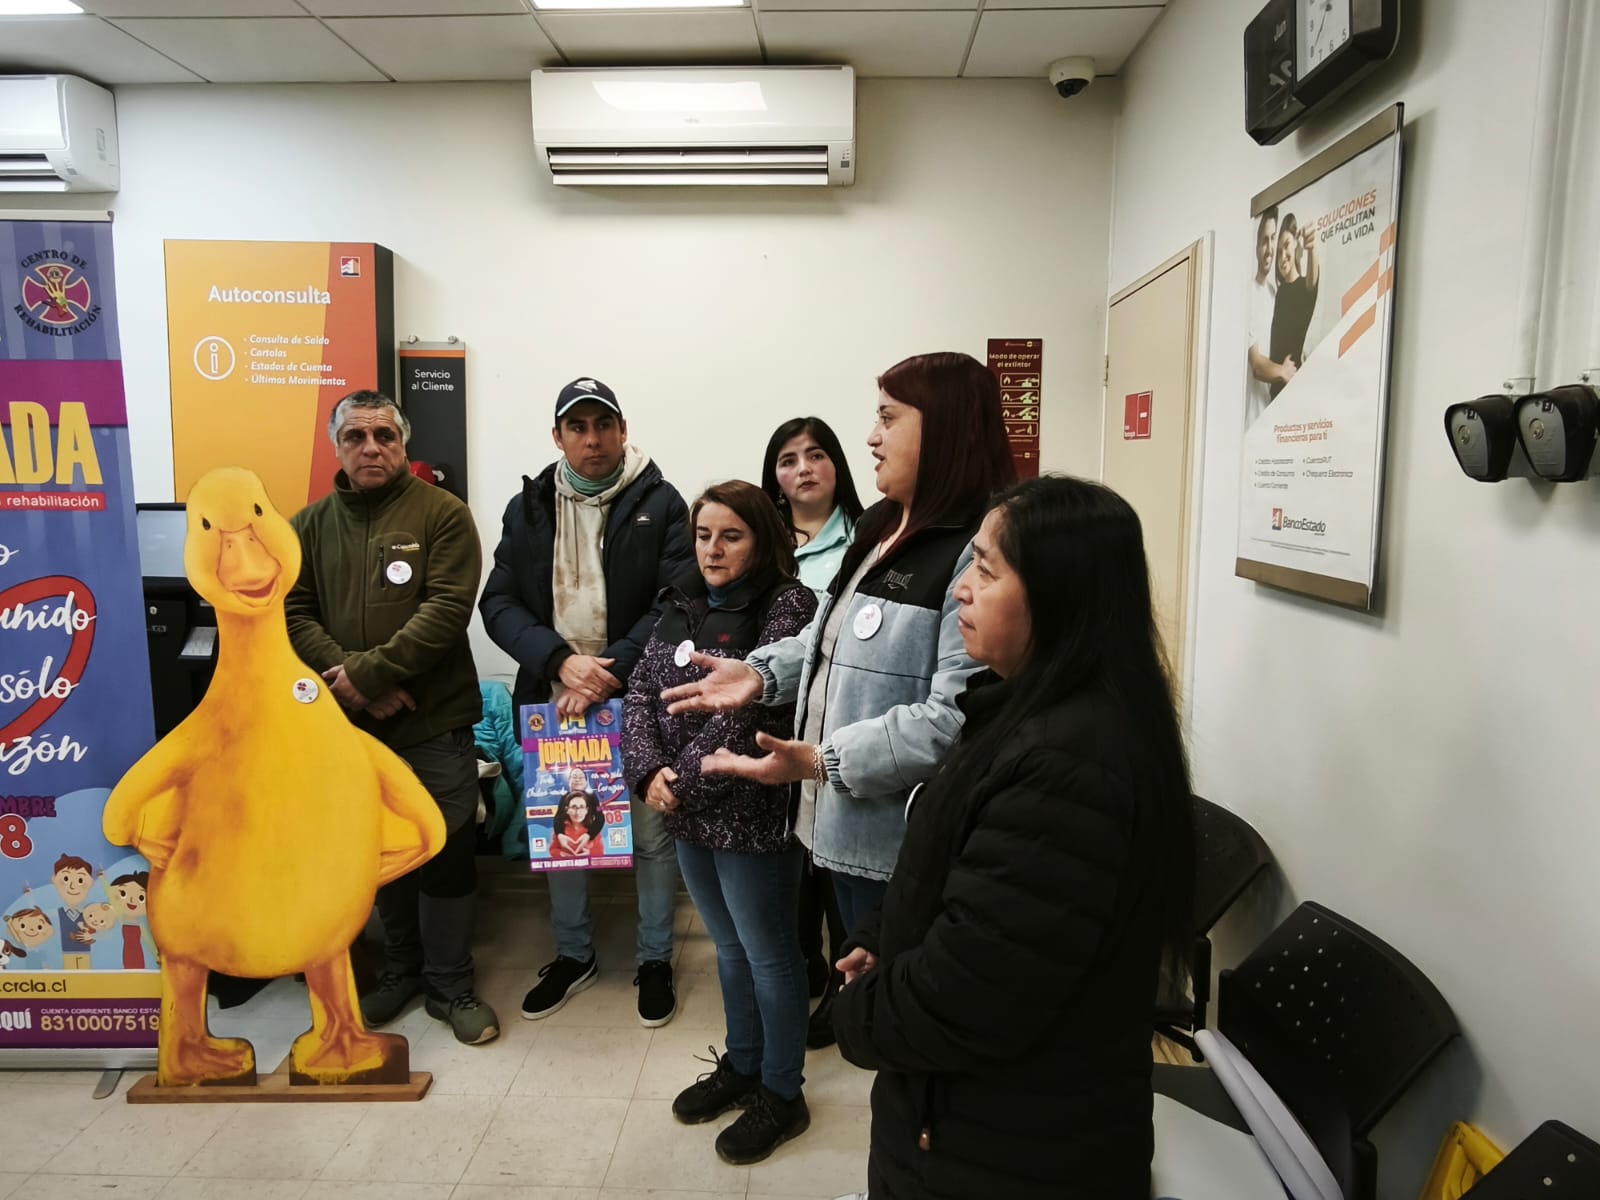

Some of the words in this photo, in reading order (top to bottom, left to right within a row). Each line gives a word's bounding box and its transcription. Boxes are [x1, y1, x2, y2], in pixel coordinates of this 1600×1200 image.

[1316, 188, 1377, 230] SOLUCIONES
[1320, 226, 1334, 243] QUE
[1335, 206, 1376, 234] FACILITAN
[1341, 232, 1353, 245] LA
[1353, 221, 1375, 239] VIDA
[21, 249, 69, 269] CENTRO
[71, 254, 88, 270] DE
[208, 285, 331, 305] Autoconsulta
[14, 302, 102, 337] REHABILITACIÓN
[249, 334, 289, 345] Consulta
[290, 335, 302, 345] de
[304, 335, 330, 345] Saldo
[249, 347, 287, 358] Cartolas
[250, 361, 285, 371] Estados
[287, 362, 298, 371] de
[299, 362, 333, 372] Cuenta
[414, 369, 451, 379] Servicio
[288, 375, 346, 386] Movimientos
[411, 381, 420, 390] al
[421, 381, 455, 391] Cliente
[1273, 422, 1302, 433] Productos
[1307, 419, 1333, 431] servicios
[1309, 431, 1322, 443] para
[6, 495, 100, 508] rehabilitación
[1282, 516, 1326, 533] BancoEstado
[0, 656, 80, 703] sólo
[537, 737, 612, 771] JORNADA
[605, 810, 624, 824] 08
[40, 1015, 160, 1032] 8310007519
